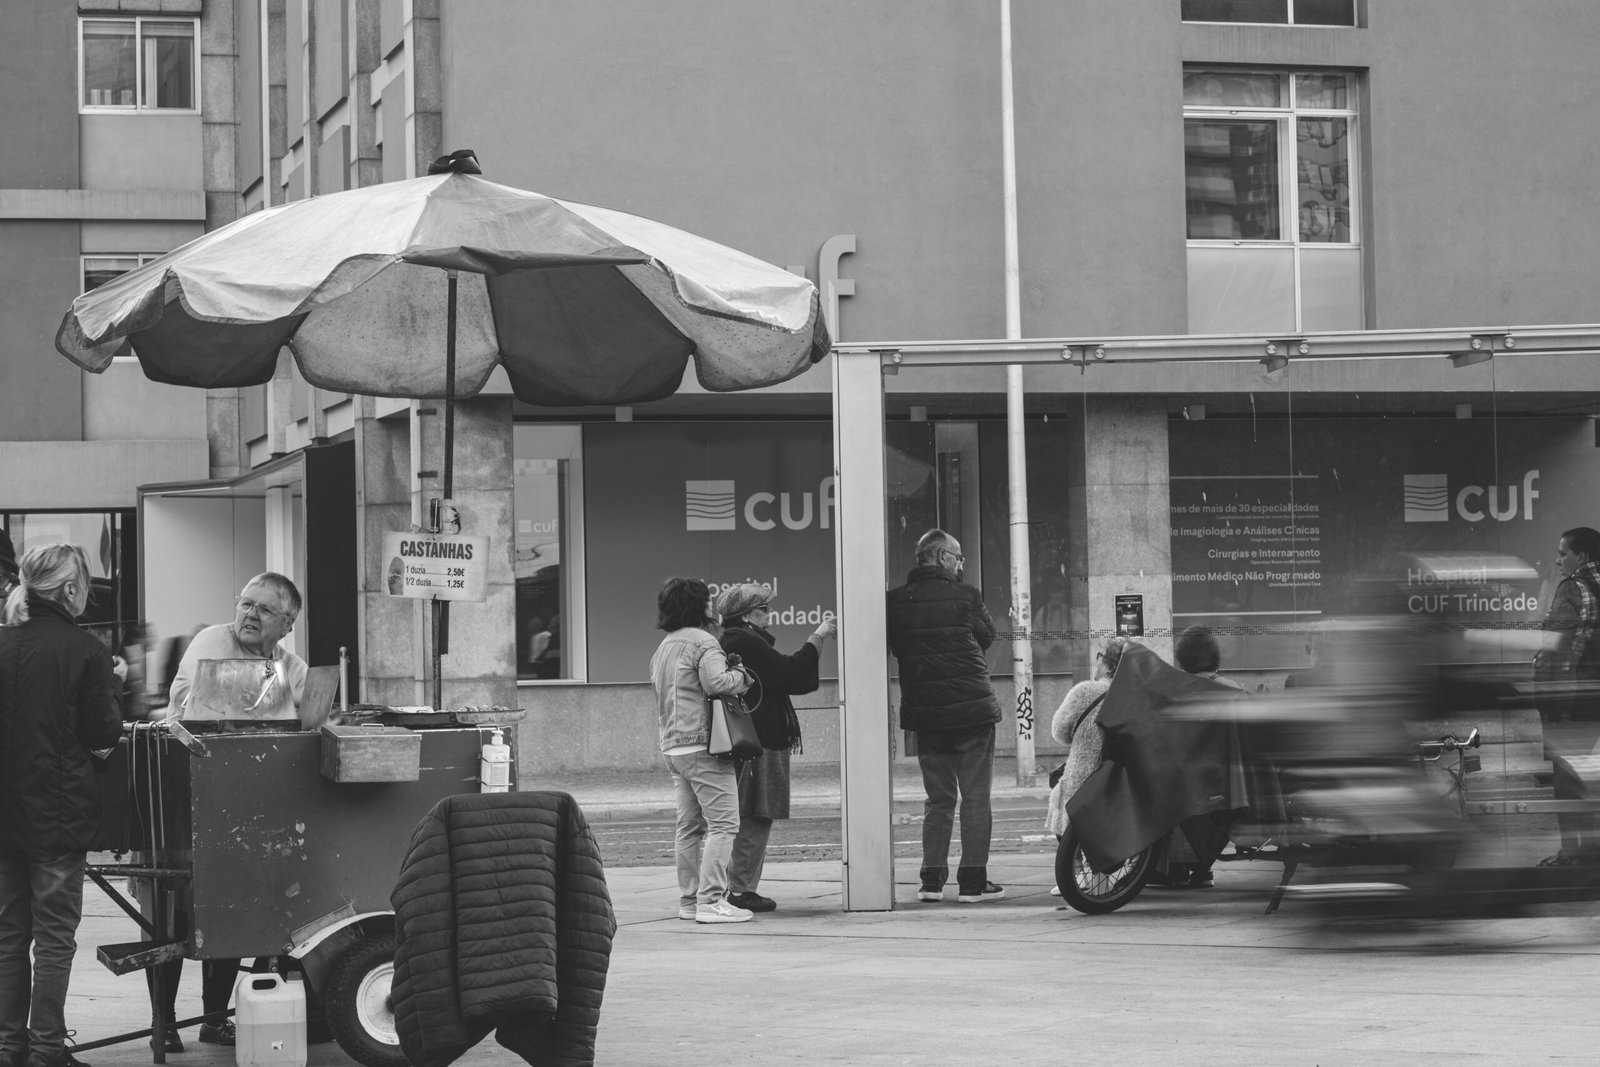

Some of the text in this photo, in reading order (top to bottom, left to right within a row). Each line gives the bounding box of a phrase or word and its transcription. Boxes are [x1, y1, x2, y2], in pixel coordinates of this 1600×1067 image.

[1456, 469, 1539, 522] cuf
[744, 476, 835, 531] cuf
[1188, 503, 1201, 513] de
[1202, 503, 1223, 513] mais
[1225, 503, 1237, 513] de
[1239, 503, 1250, 513] 30
[533, 519, 558, 533] cuf
[1180, 525, 1234, 538] Imagiologia
[1235, 528, 1242, 536] e
[1243, 524, 1282, 536] Análises
[1283, 524, 1320, 536] Cnicas
[400, 540, 473, 560] CASTANHAS
[1207, 548, 1250, 561] Cirurgias
[1251, 550, 1257, 558] e
[447, 567, 465, 577] 2,50€
[1207, 570, 1244, 581] Médico
[1245, 570, 1264, 581] Não
[1265, 569, 1321, 583] Progrmado
[405, 577, 415, 586] 1/2
[447, 579, 465, 589] 1,25€
[1408, 594, 1449, 613] CUF
